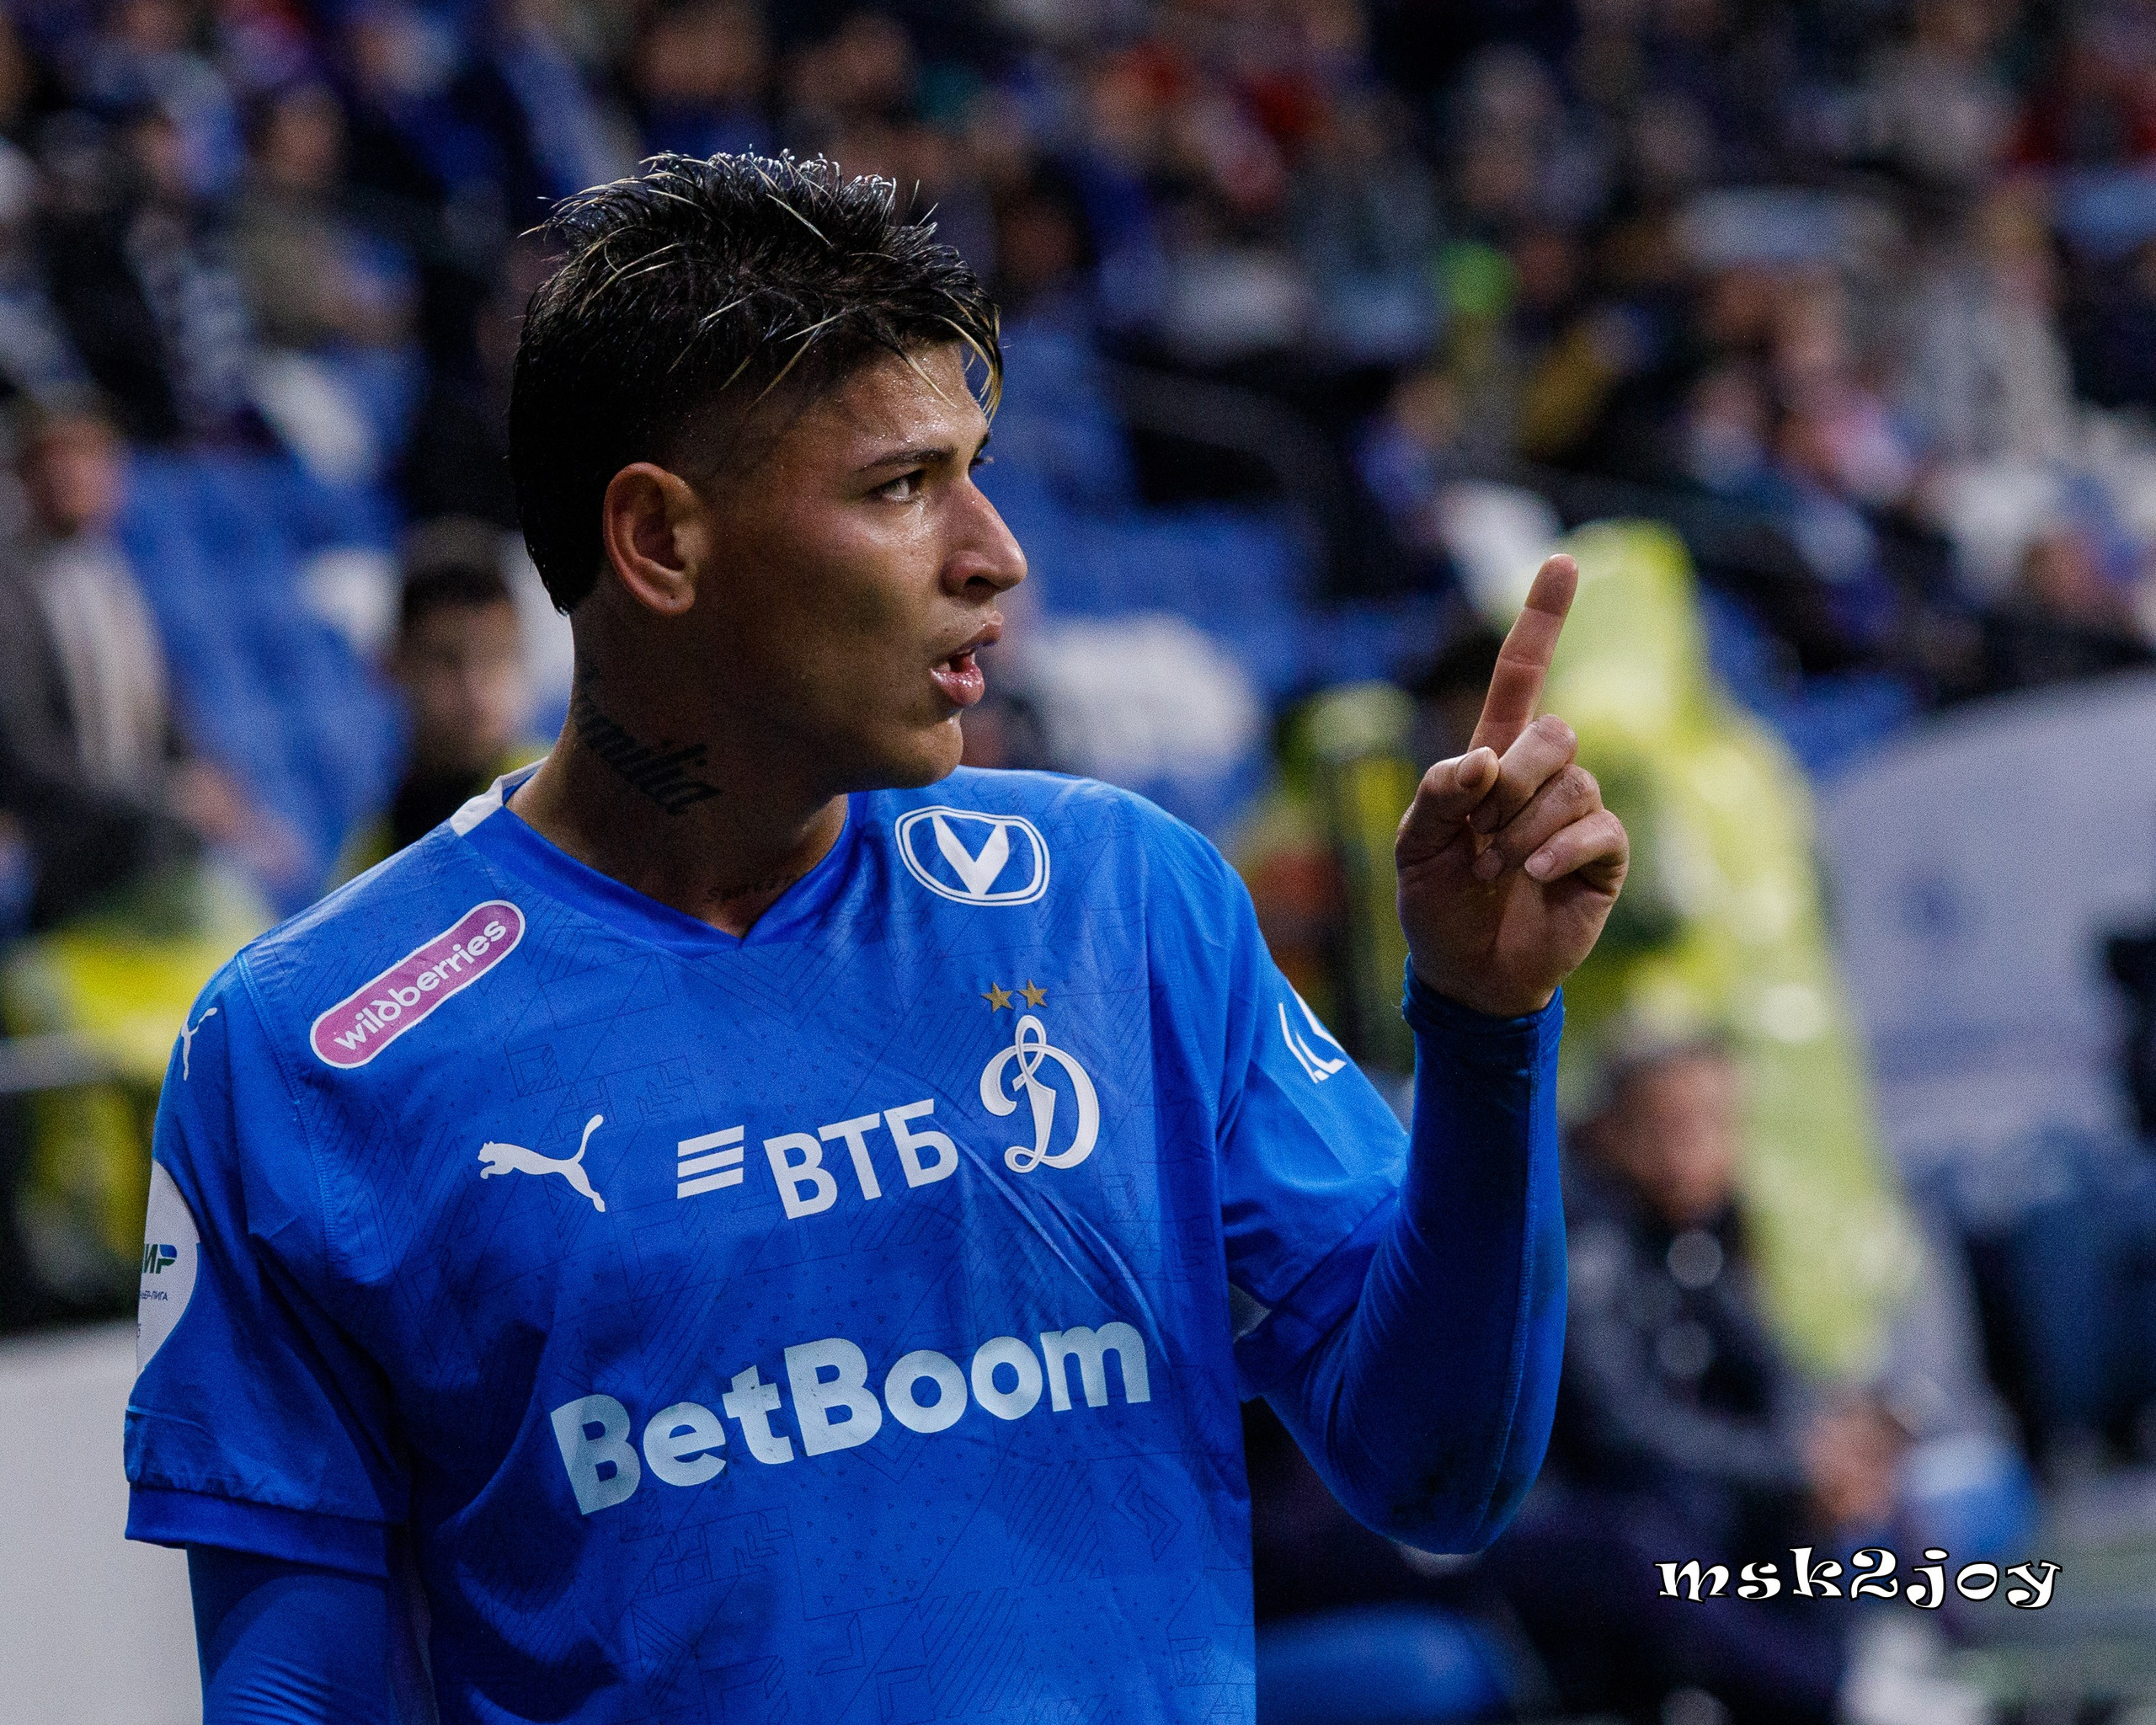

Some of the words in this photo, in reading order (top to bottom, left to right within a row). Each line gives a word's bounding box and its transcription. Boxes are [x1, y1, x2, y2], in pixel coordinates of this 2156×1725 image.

[334, 921, 506, 1050] wildberries
[763, 1098, 959, 1220] ВТБ
[142, 1244, 178, 1274] ИР
[550, 1322, 1151, 1515] BetBoom
